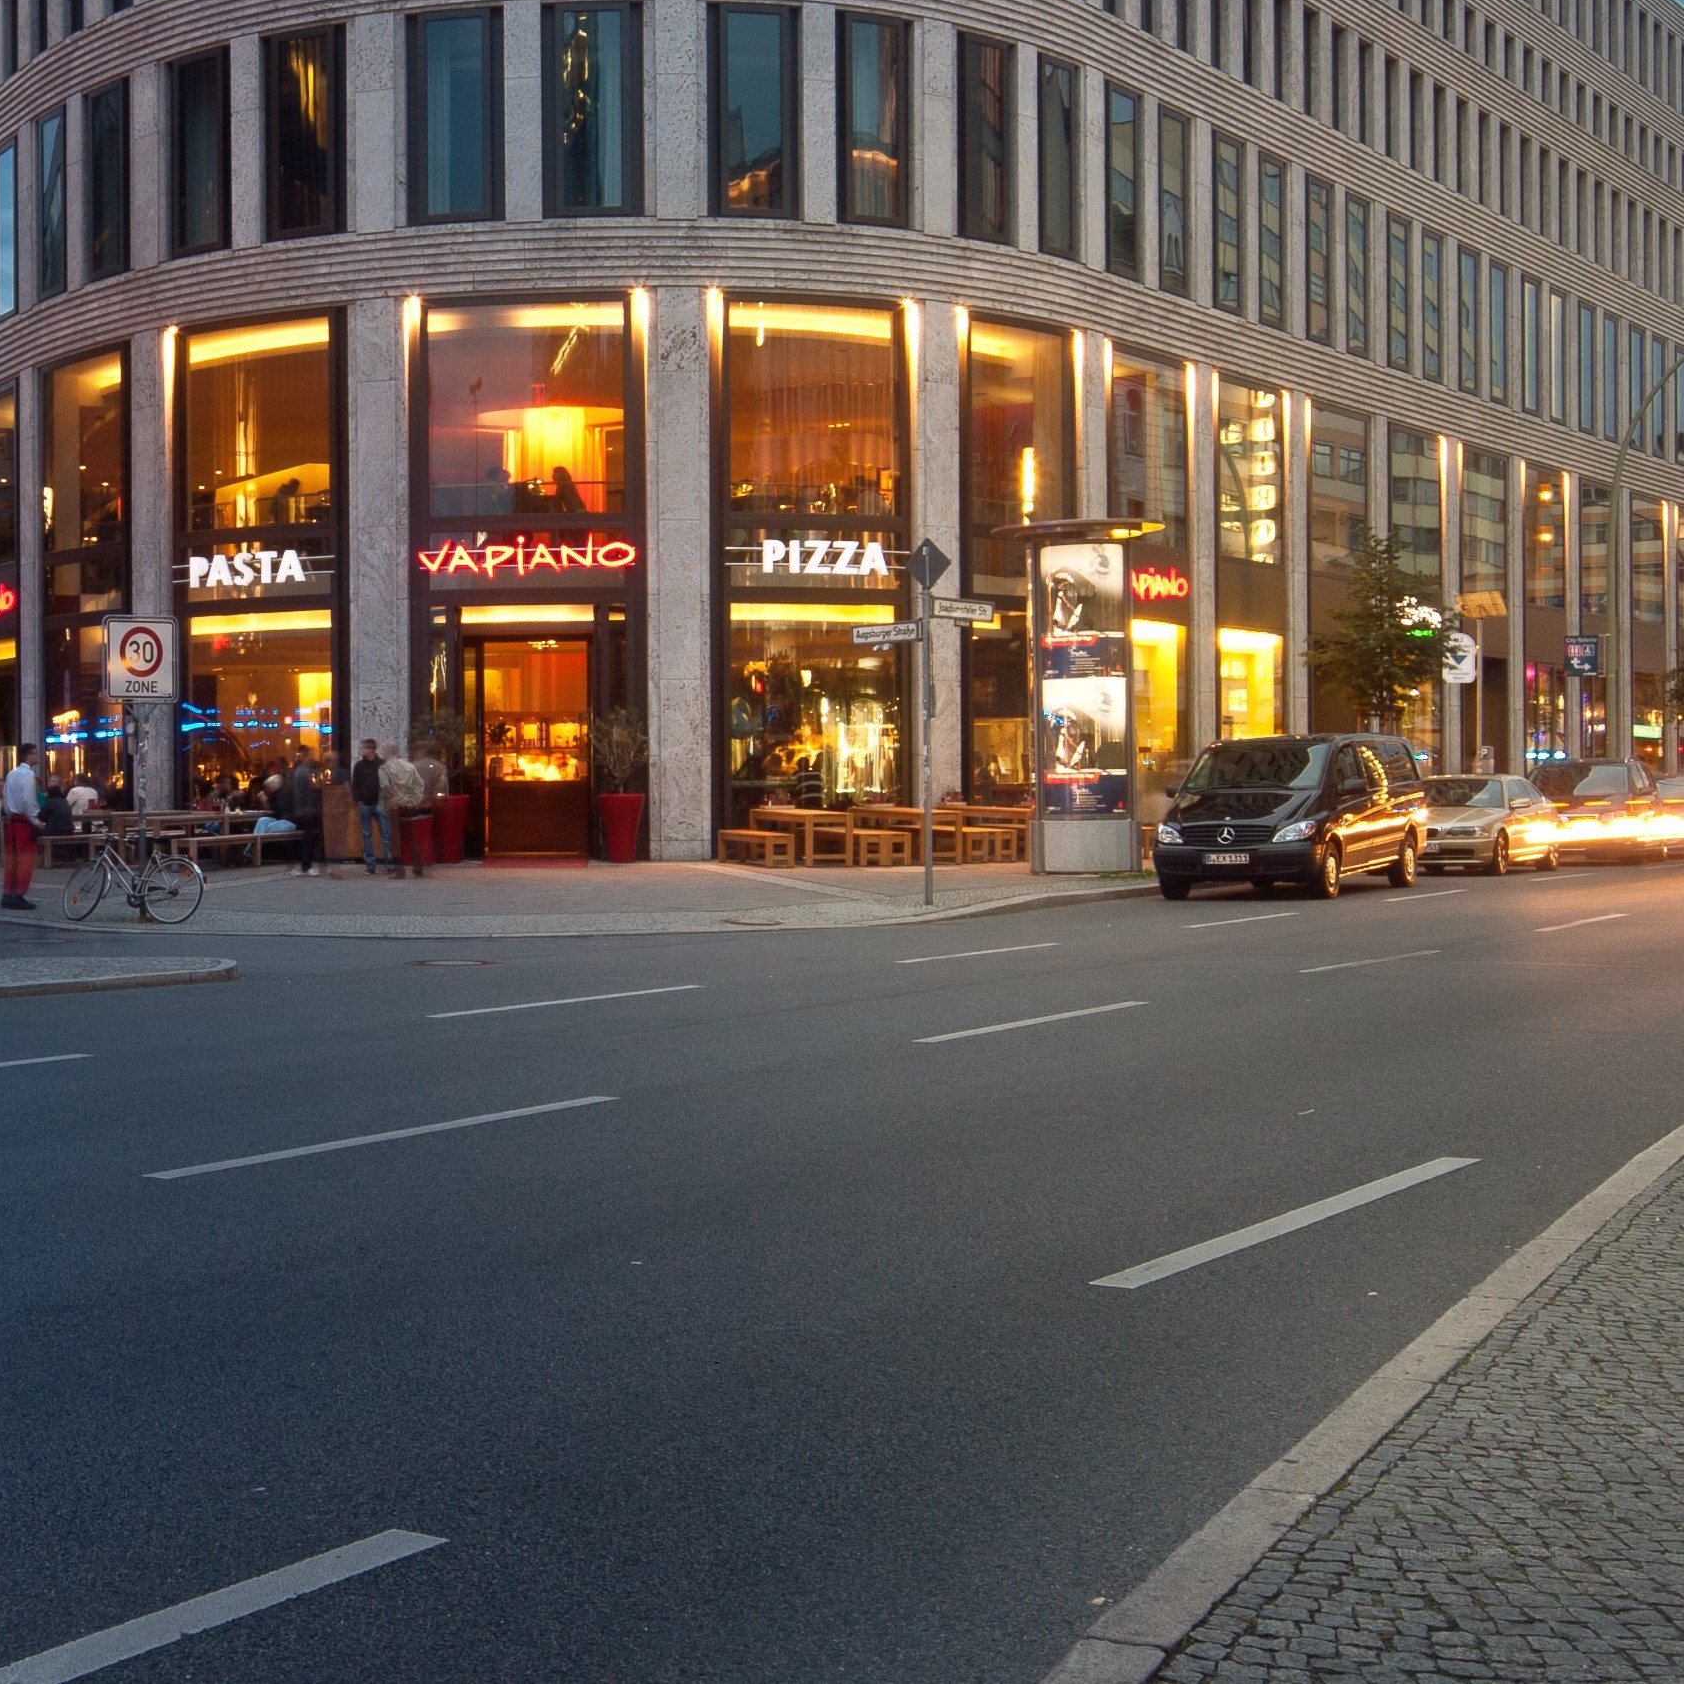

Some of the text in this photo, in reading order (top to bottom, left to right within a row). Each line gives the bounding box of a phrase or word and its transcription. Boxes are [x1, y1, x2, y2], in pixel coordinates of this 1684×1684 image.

[189, 549, 306, 589] PASTA
[762, 539, 889, 576] PIZZA
[856, 625, 915, 641] Augsburger Straße
[129, 640, 154, 664] 30
[125, 680, 158, 693] ZONE
